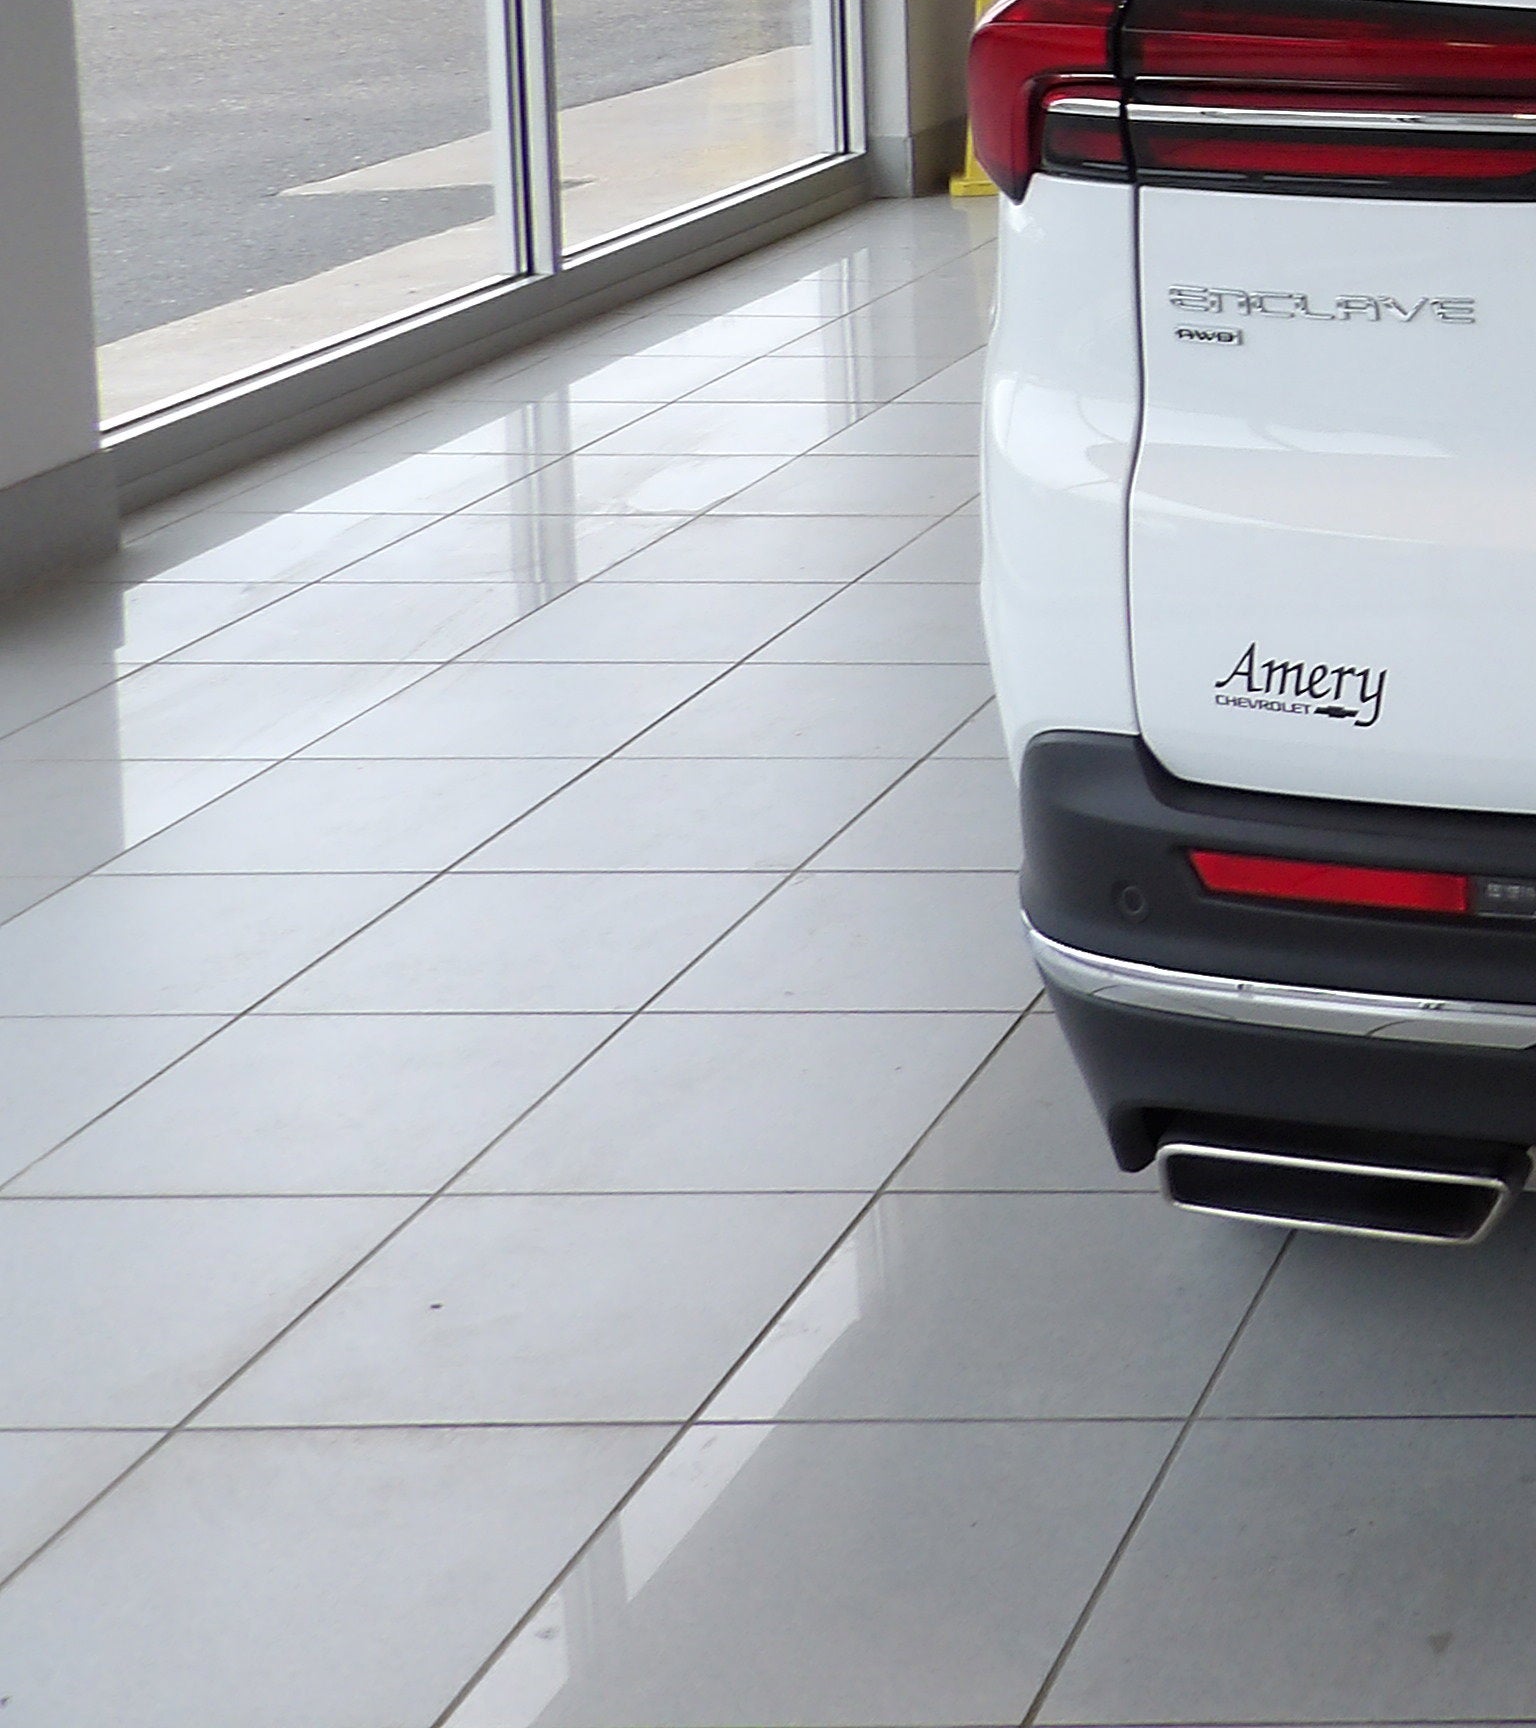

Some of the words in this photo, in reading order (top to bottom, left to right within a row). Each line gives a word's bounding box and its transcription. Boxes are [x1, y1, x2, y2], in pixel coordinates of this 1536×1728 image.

[1168, 284, 1476, 323] ENCLAVE
[1174, 327, 1236, 345] AWD
[1214, 641, 1388, 727] Amery
[1215, 694, 1311, 714] CHEVROLET
